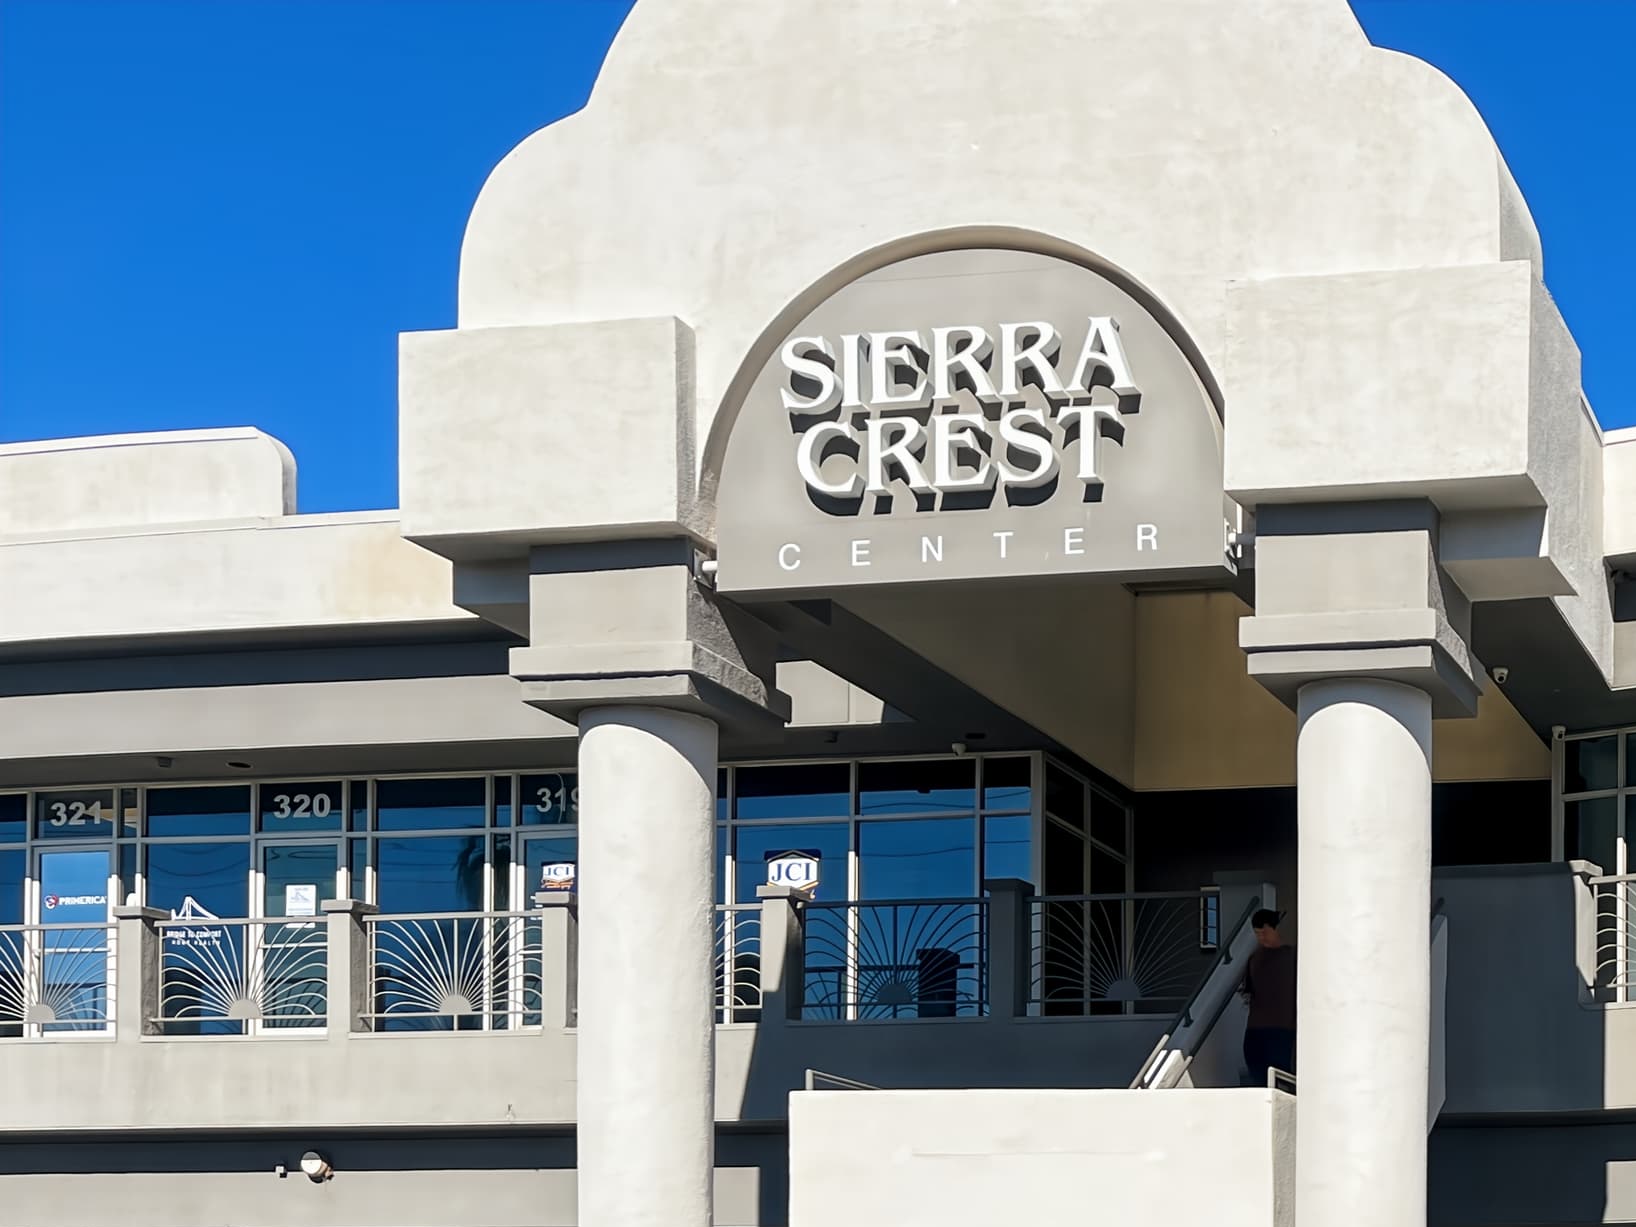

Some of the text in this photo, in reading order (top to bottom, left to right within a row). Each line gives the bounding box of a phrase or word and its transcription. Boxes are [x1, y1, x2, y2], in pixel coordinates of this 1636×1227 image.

[779, 315, 1142, 420] SIERRA
[796, 403, 1124, 502] CREST
[778, 523, 1159, 571] CENTER
[50, 800, 102, 827] 321
[273, 793, 331, 819] 320
[771, 862, 812, 882] JCI
[59, 896, 107, 905] PRIMERICA
